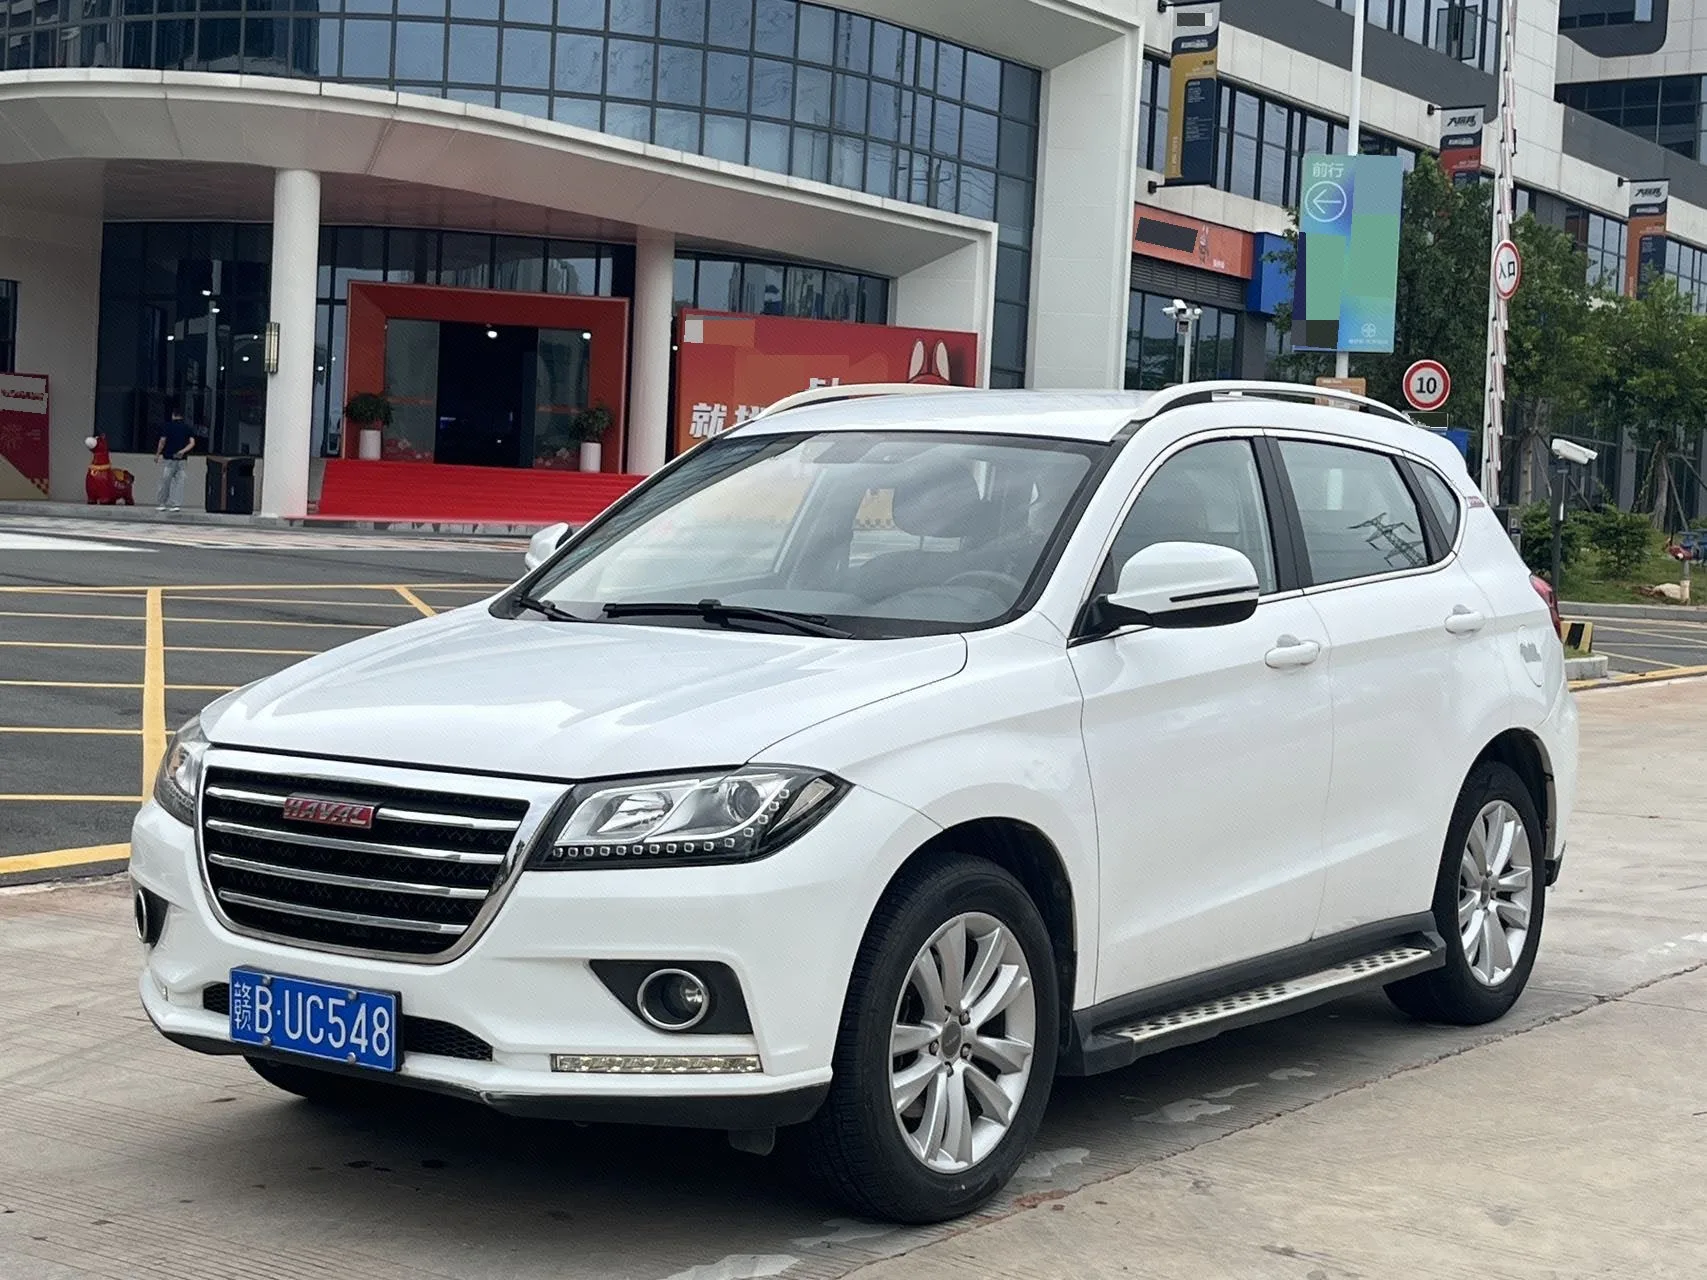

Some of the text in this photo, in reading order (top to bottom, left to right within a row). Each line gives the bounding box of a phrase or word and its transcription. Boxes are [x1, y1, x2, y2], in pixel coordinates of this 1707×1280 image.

[1312, 162, 1344, 178] 前行
[1498, 261, 1516, 280] 入口
[1415, 377, 1437, 394] 10
[283, 799, 369, 825] HAVAL
